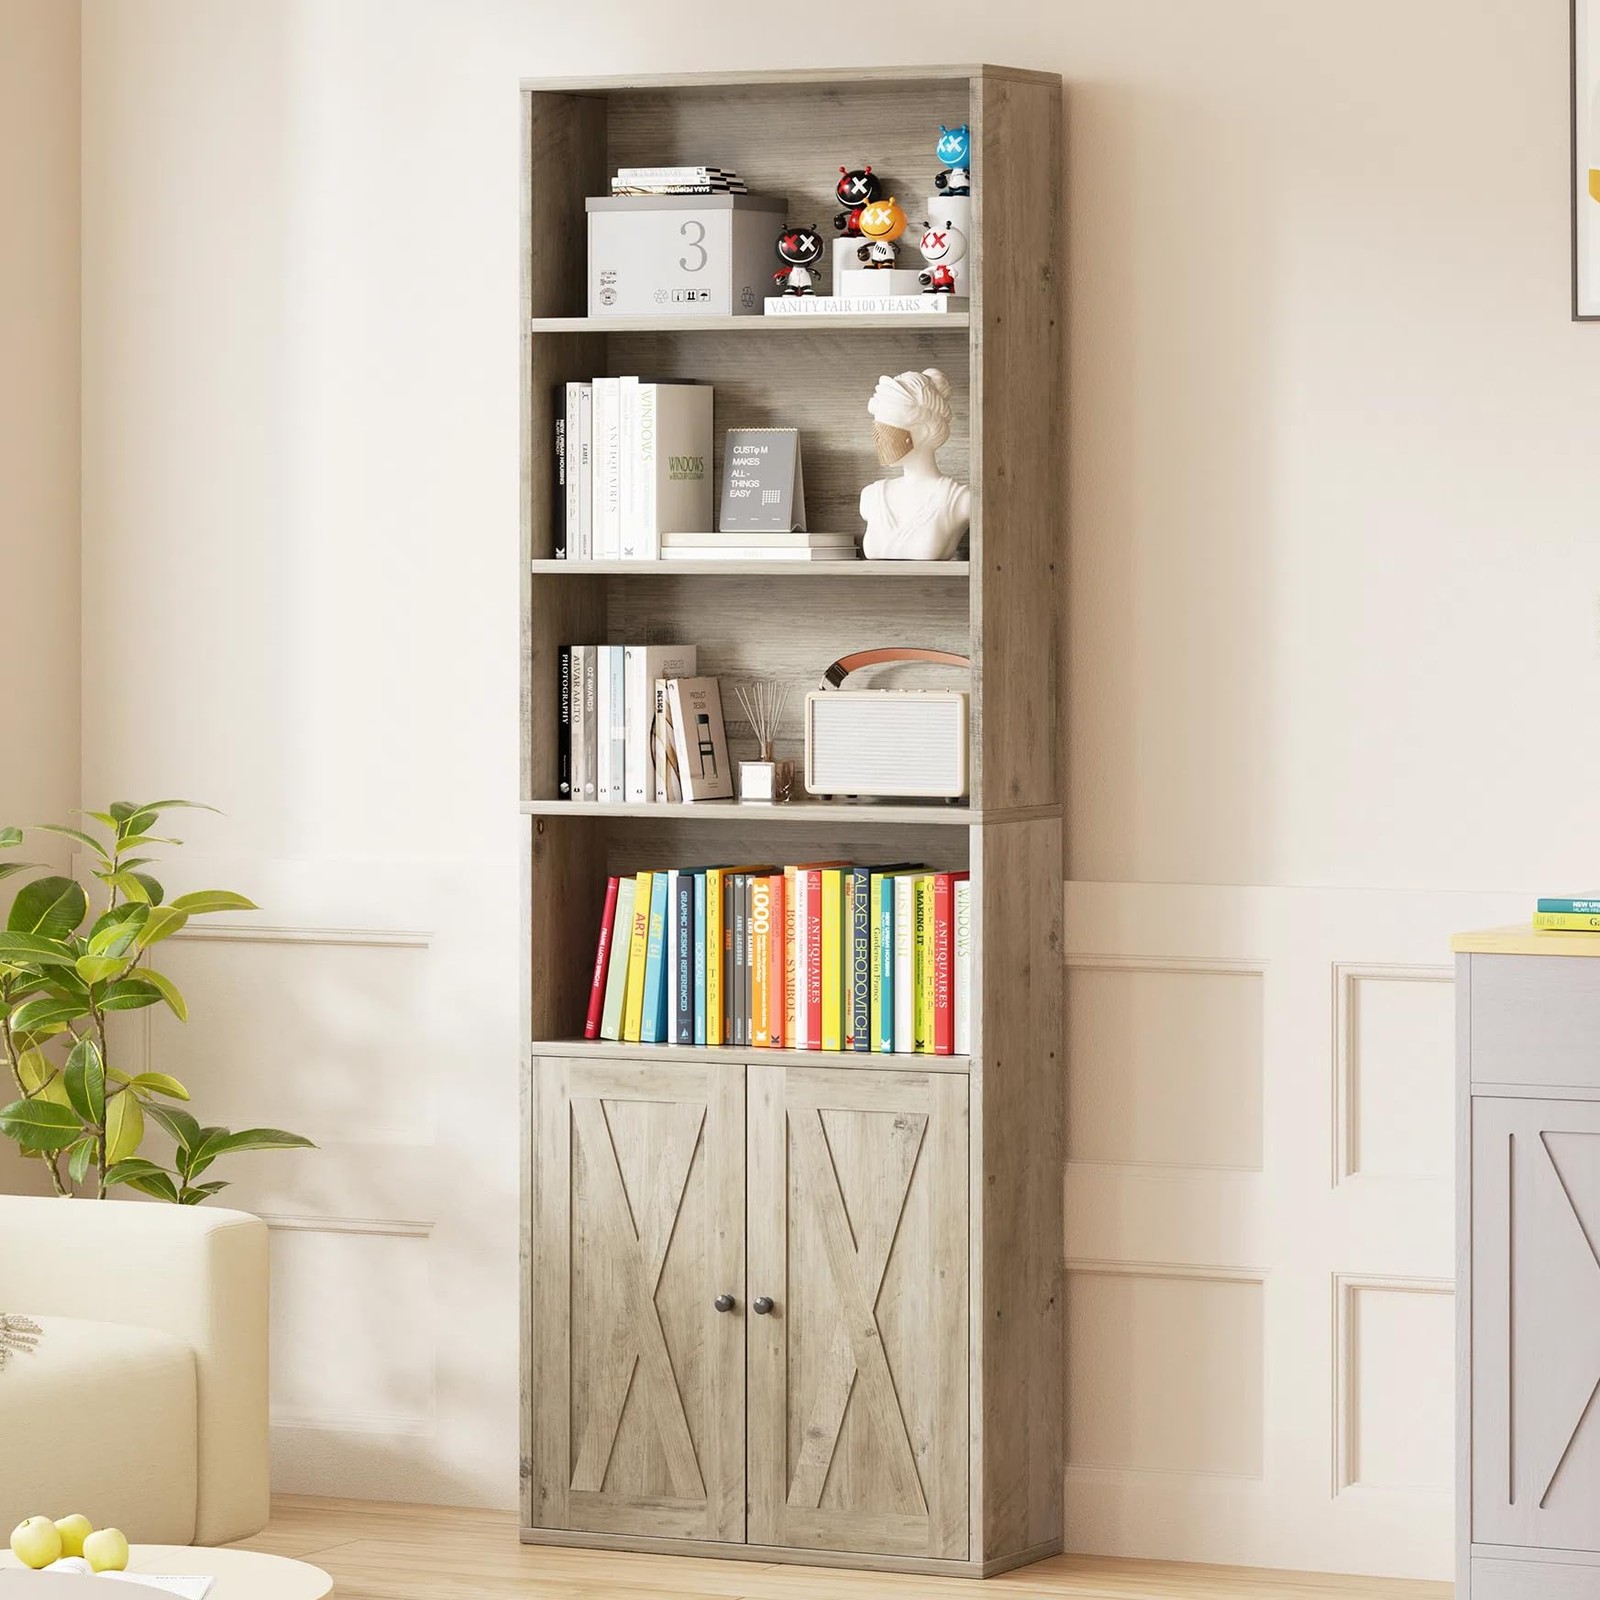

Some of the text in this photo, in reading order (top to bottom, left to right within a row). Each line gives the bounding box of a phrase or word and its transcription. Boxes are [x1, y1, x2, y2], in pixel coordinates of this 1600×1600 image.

[679, 220, 708, 272] 3
[771, 299, 921, 313] VANITY FAIR 100 YEARS
[640, 389, 653, 462] WINDOWS
[668, 456, 705, 472] WINDOWS
[731, 470, 745, 478] ALL
[732, 458, 760, 466] MAKES
[729, 490, 751, 498] EASY
[731, 480, 760, 488] THINGS
[635, 912, 645, 939] ART
[651, 913, 662, 940] ART
[680, 890, 688, 927] GRAPHIC
[753, 883, 770, 934] 1000
[916, 889, 924, 932] MAKING
[957, 887, 970, 958] WINDOWS
[598, 927, 608, 946] FRANK
[680, 928, 688, 958] DESIGN
[786, 909, 795, 945] BOOK
[873, 926, 881, 962] Gardens
[916, 935, 924, 946] IT
[810, 915, 820, 1004] ANTIQUAIRES
[855, 873, 867, 1039] ALEXEY BRODOVITCH
[874, 963, 881, 972] in
[937, 919, 948, 1009] ANTIQUAIRES
[680, 959, 688, 1012] REFERENCED
[786, 959, 795, 1023] SYMBOLS
